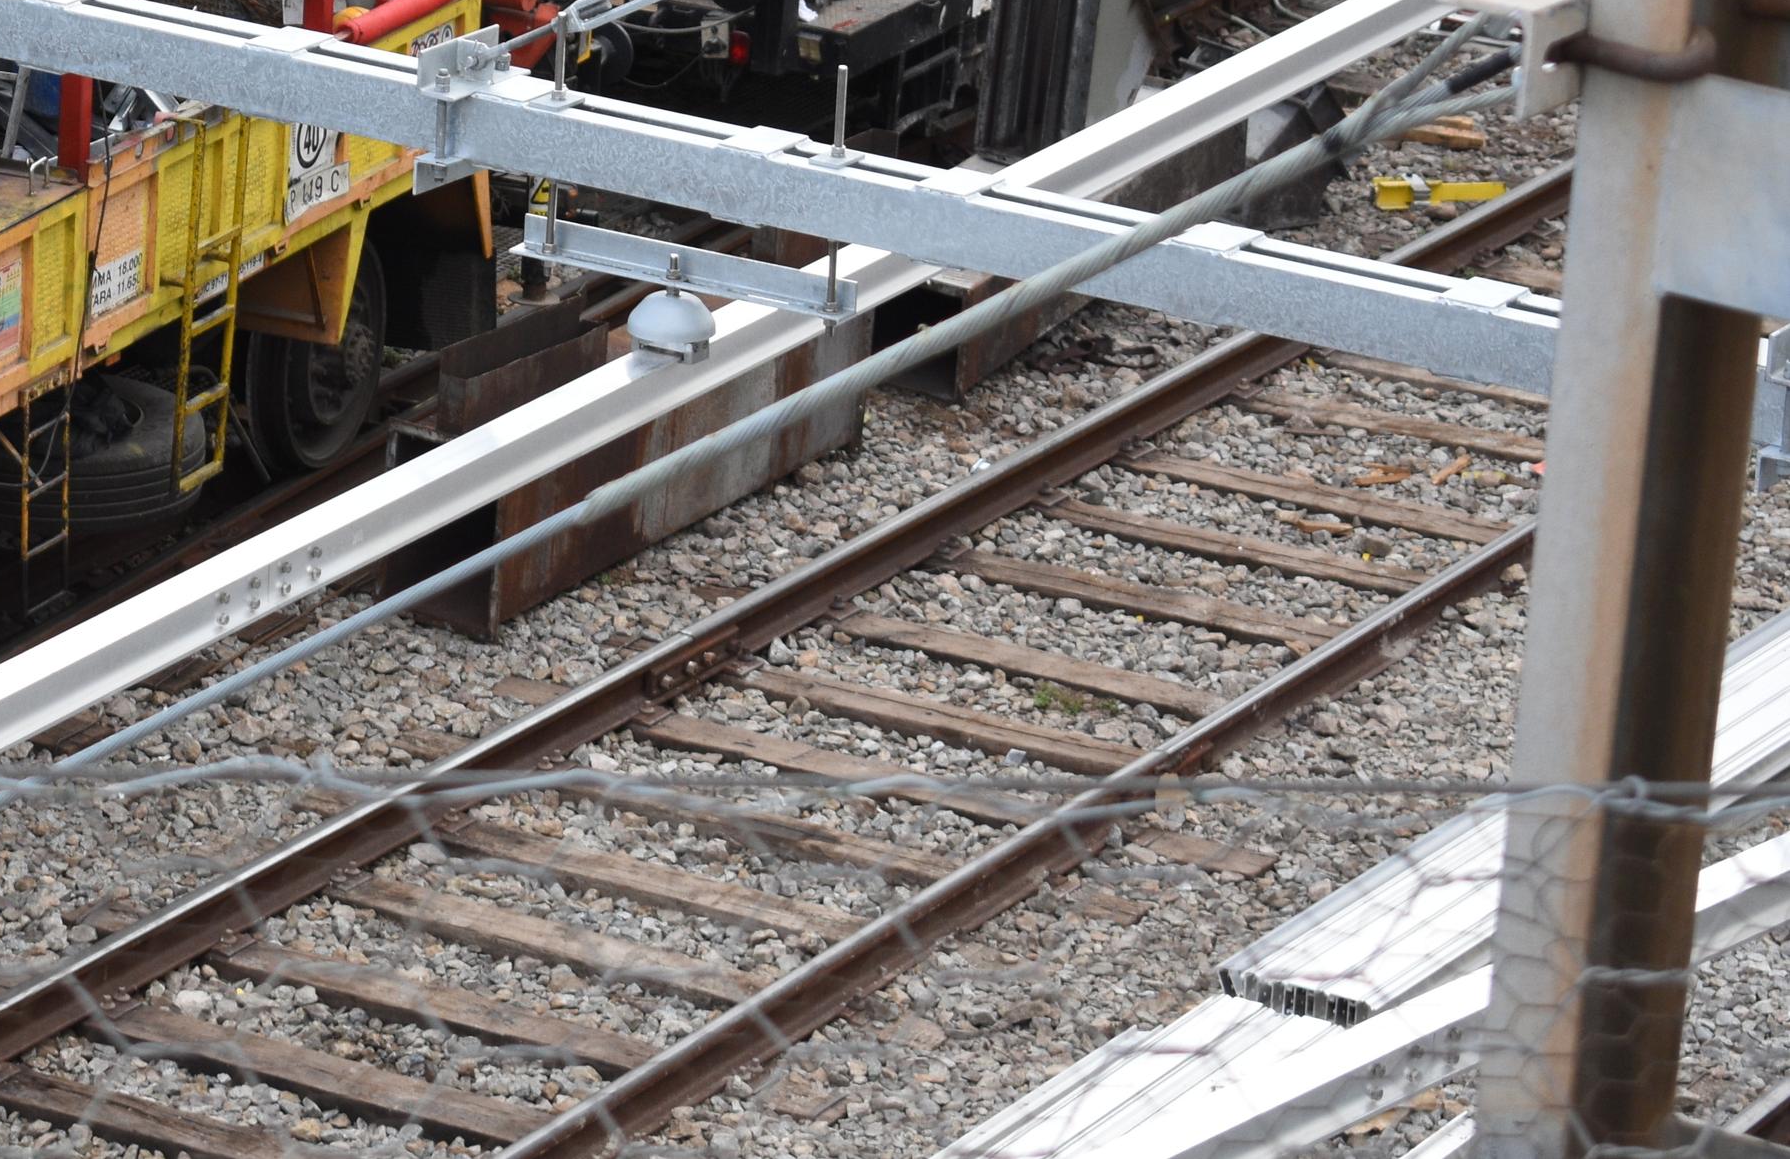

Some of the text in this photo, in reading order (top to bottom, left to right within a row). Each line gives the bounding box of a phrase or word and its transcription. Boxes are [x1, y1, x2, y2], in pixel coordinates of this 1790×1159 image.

[330, 169, 340, 193] C
[117, 252, 143, 276] 18.000
[91, 289, 113, 307] ARA
